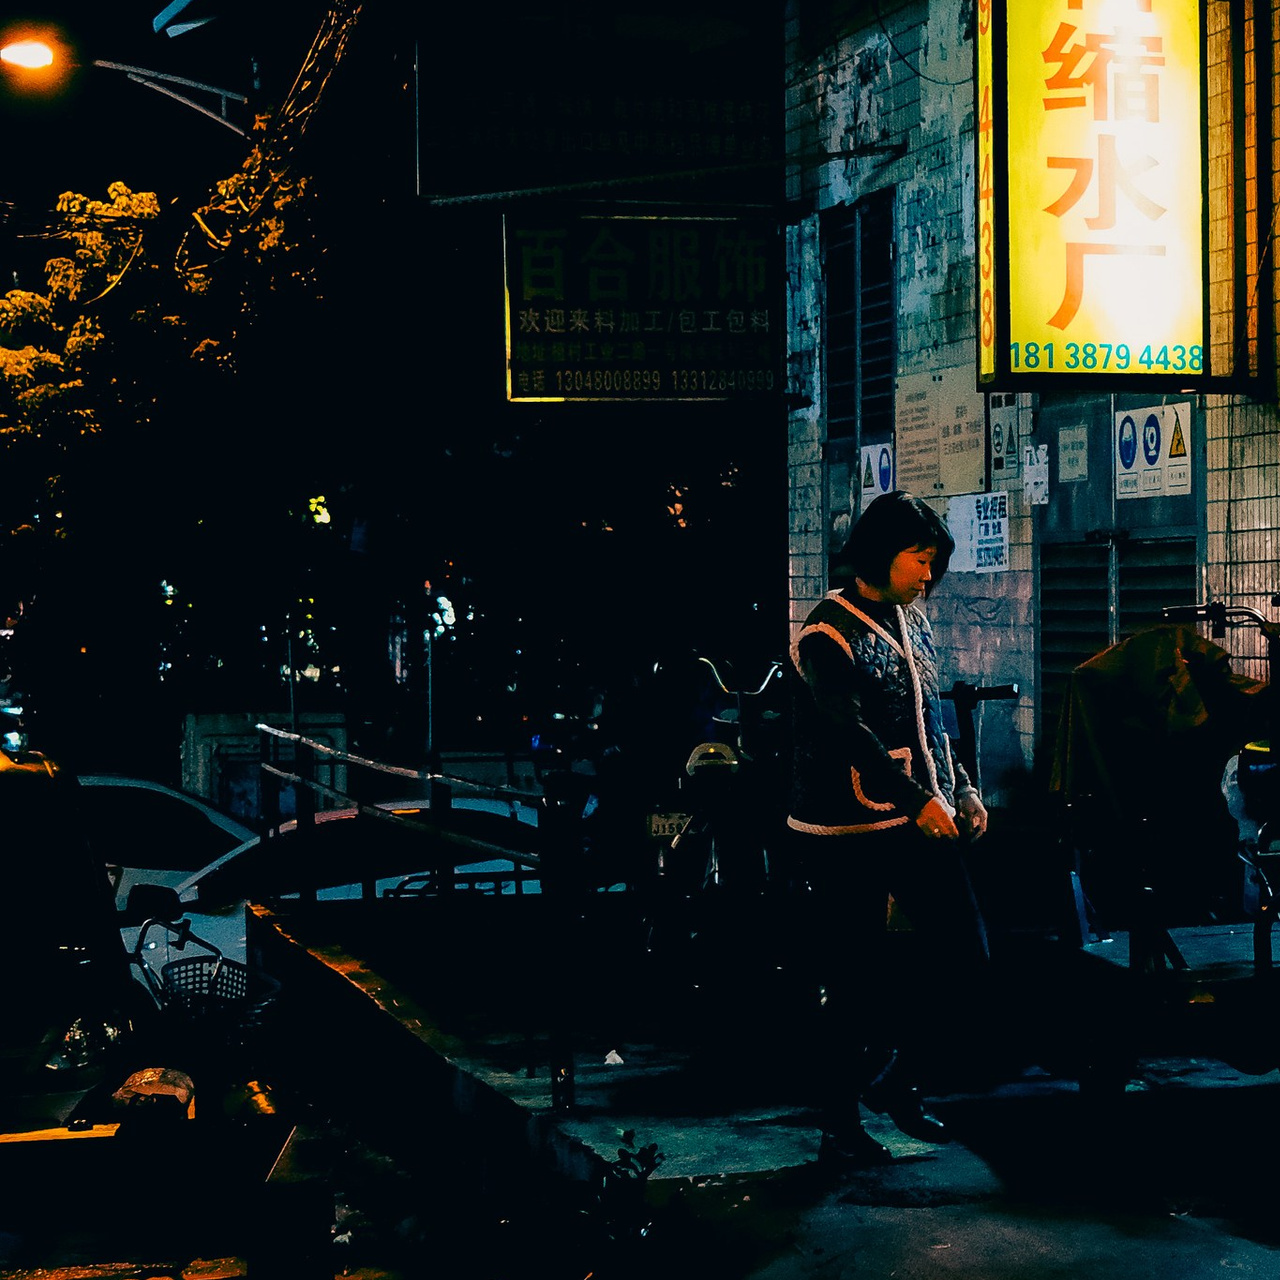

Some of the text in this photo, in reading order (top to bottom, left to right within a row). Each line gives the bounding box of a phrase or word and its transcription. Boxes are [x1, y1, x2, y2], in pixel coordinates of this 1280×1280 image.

[979, 85, 994, 348] 4438
[516, 226, 768, 301] 百合服饰
[518, 309, 770, 335] 欢迎来料加工/包工包料
[1010, 342, 1203, 371] 181 3879 4438
[517, 372, 545, 392] 电话
[555, 369, 661, 391] 13048008899
